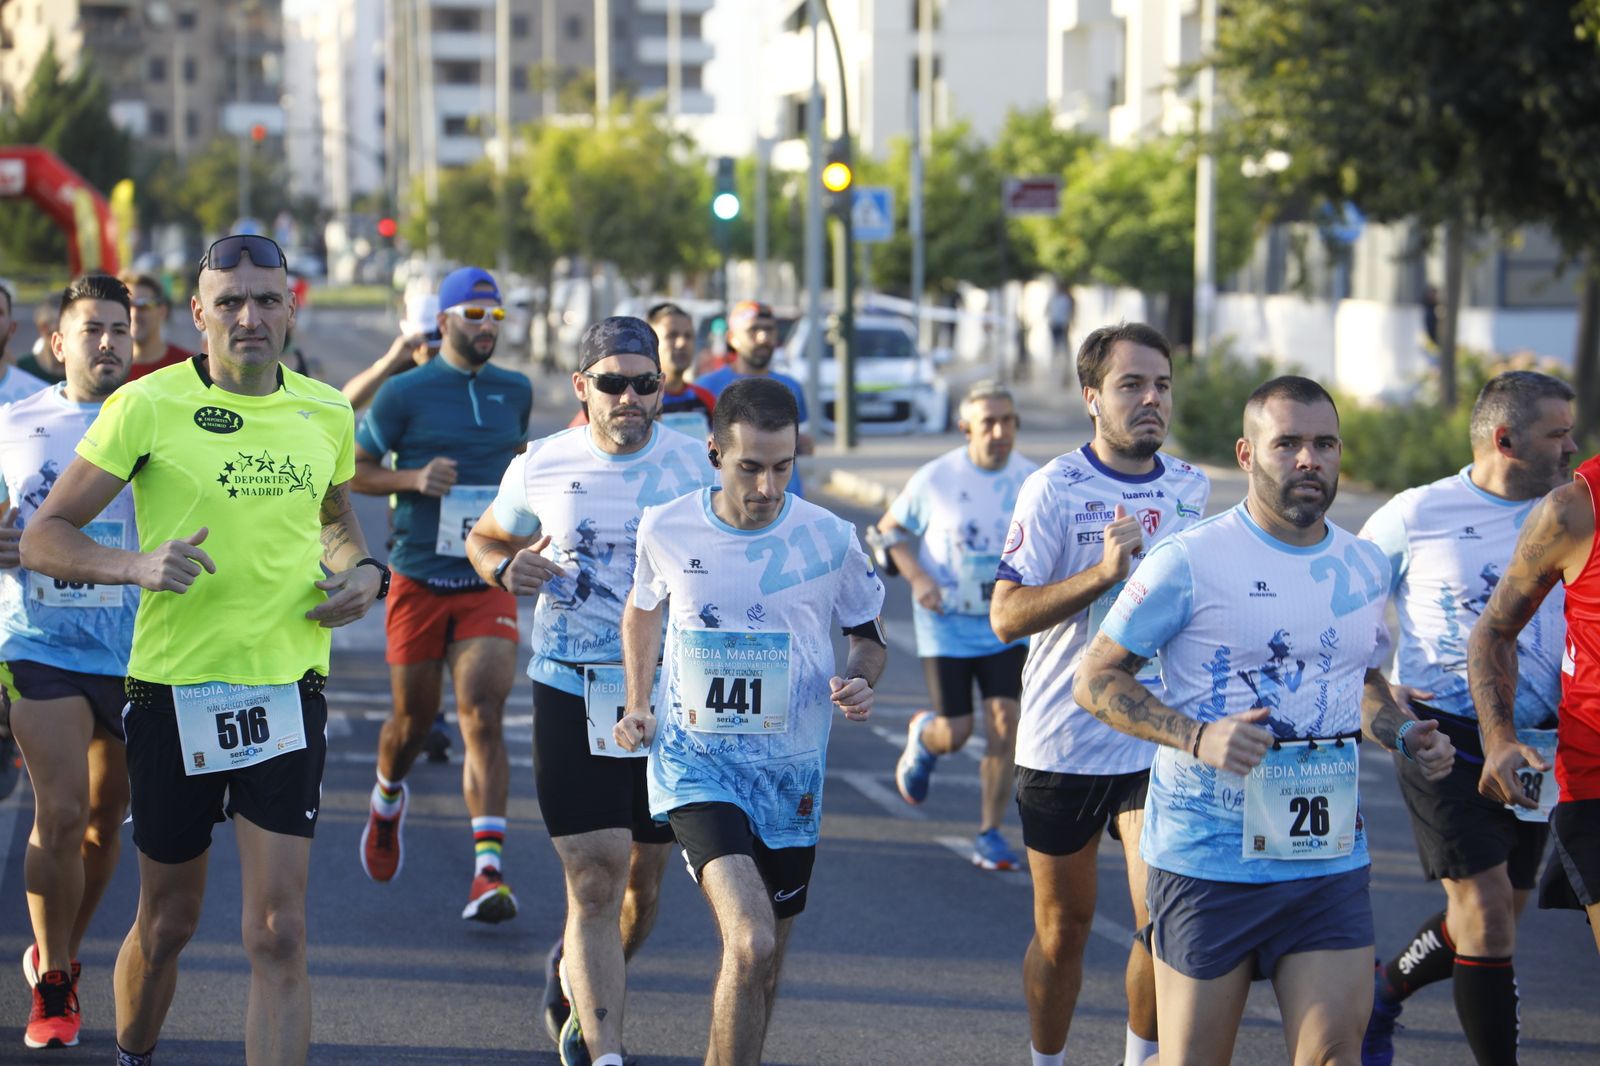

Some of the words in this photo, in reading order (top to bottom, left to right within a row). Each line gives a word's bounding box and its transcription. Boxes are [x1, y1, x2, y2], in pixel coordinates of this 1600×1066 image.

[234, 475, 290, 485] DEPORTES
[241, 487, 284, 497] MADRID
[1122, 489, 1154, 500] luanvi
[684, 647, 721, 660] MEDIA
[726, 646, 788, 661] MARATÓN
[180, 684, 224, 700] MEDIA
[705, 677, 763, 715] 441
[215, 706, 270, 750] 516
[1252, 766, 1296, 780] MEDIA
[1301, 758, 1355, 777] MARATÓN
[1289, 795, 1330, 838] 26
[1398, 929, 1443, 976] WONG
